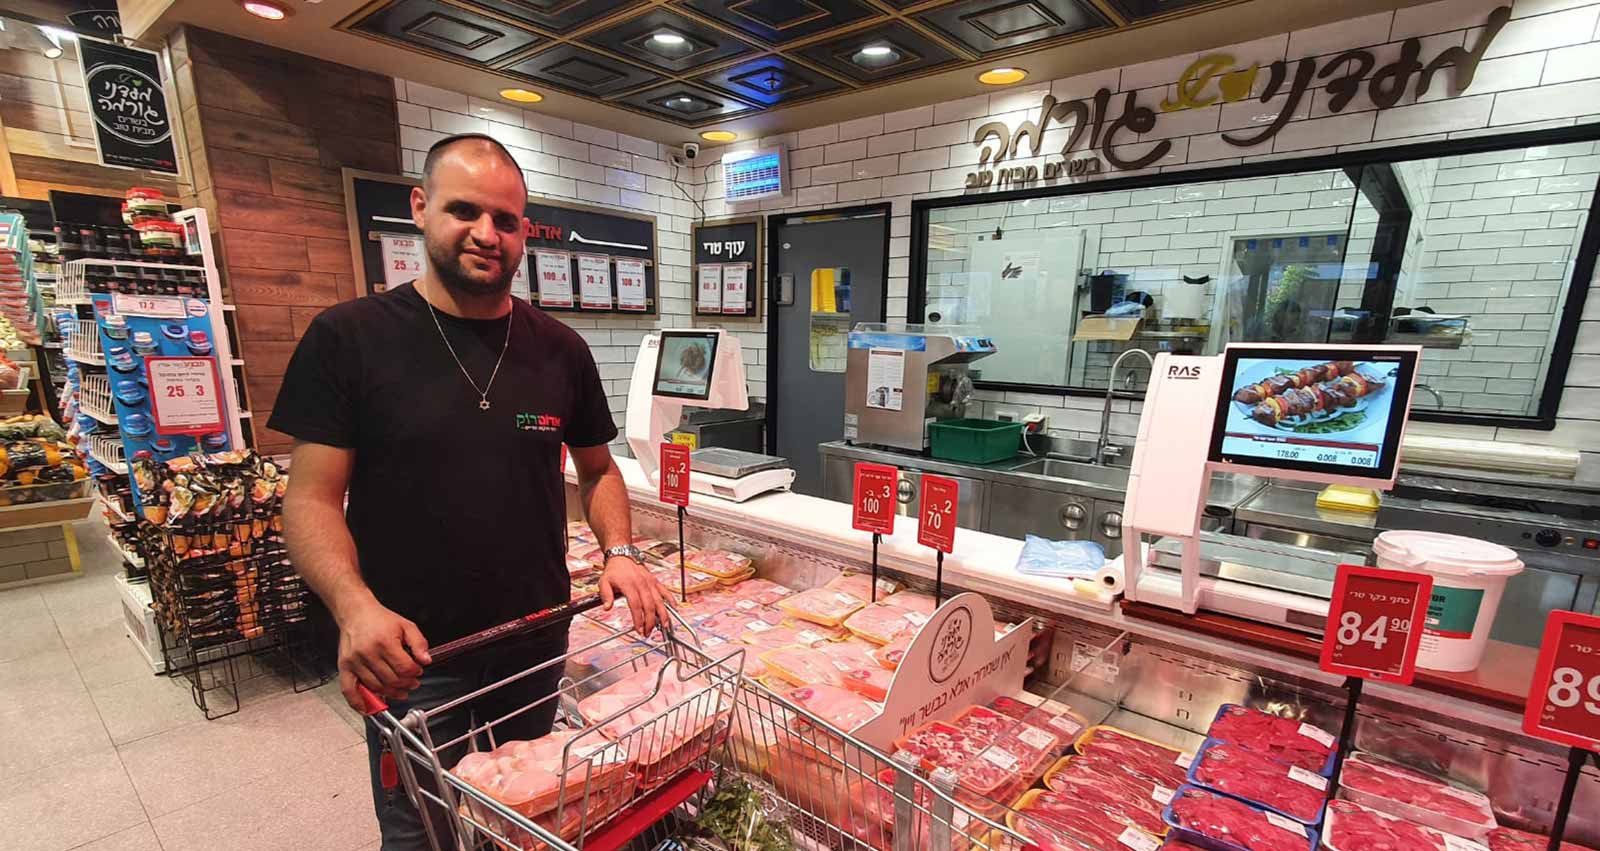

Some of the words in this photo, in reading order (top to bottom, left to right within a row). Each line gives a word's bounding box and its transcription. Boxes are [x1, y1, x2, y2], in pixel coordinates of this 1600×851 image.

[1219, 8, 1514, 148] מעדני
[98, 81, 153, 101] מעדני
[97, 98, 165, 125] גורמה
[972, 87, 1171, 171] גורמה
[998, 165, 1038, 188] מבית
[1045, 157, 1101, 181] בשרים
[966, 171, 994, 190] טוב
[702, 242, 722, 256] טרי
[725, 240, 745, 259] עוף
[394, 260, 407, 271] 25
[1168, 365, 1201, 377] RAS
[166, 385, 185, 398] 25
[195, 385, 205, 397] 3
[680, 462, 687, 475] 2
[667, 473, 679, 488] 100
[882, 485, 891, 499] 3
[862, 497, 880, 514] 100
[943, 499, 953, 515] 2
[927, 511, 942, 529] 70
[1350, 591, 1365, 599] טרי
[1369, 593, 1386, 603] בקר
[1390, 597, 1410, 605] כתף
[1337, 610, 1389, 650] 84
[1391, 618, 1410, 631] 90
[1570, 643, 1593, 654] טרי
[919, 692, 948, 721] בבשר
